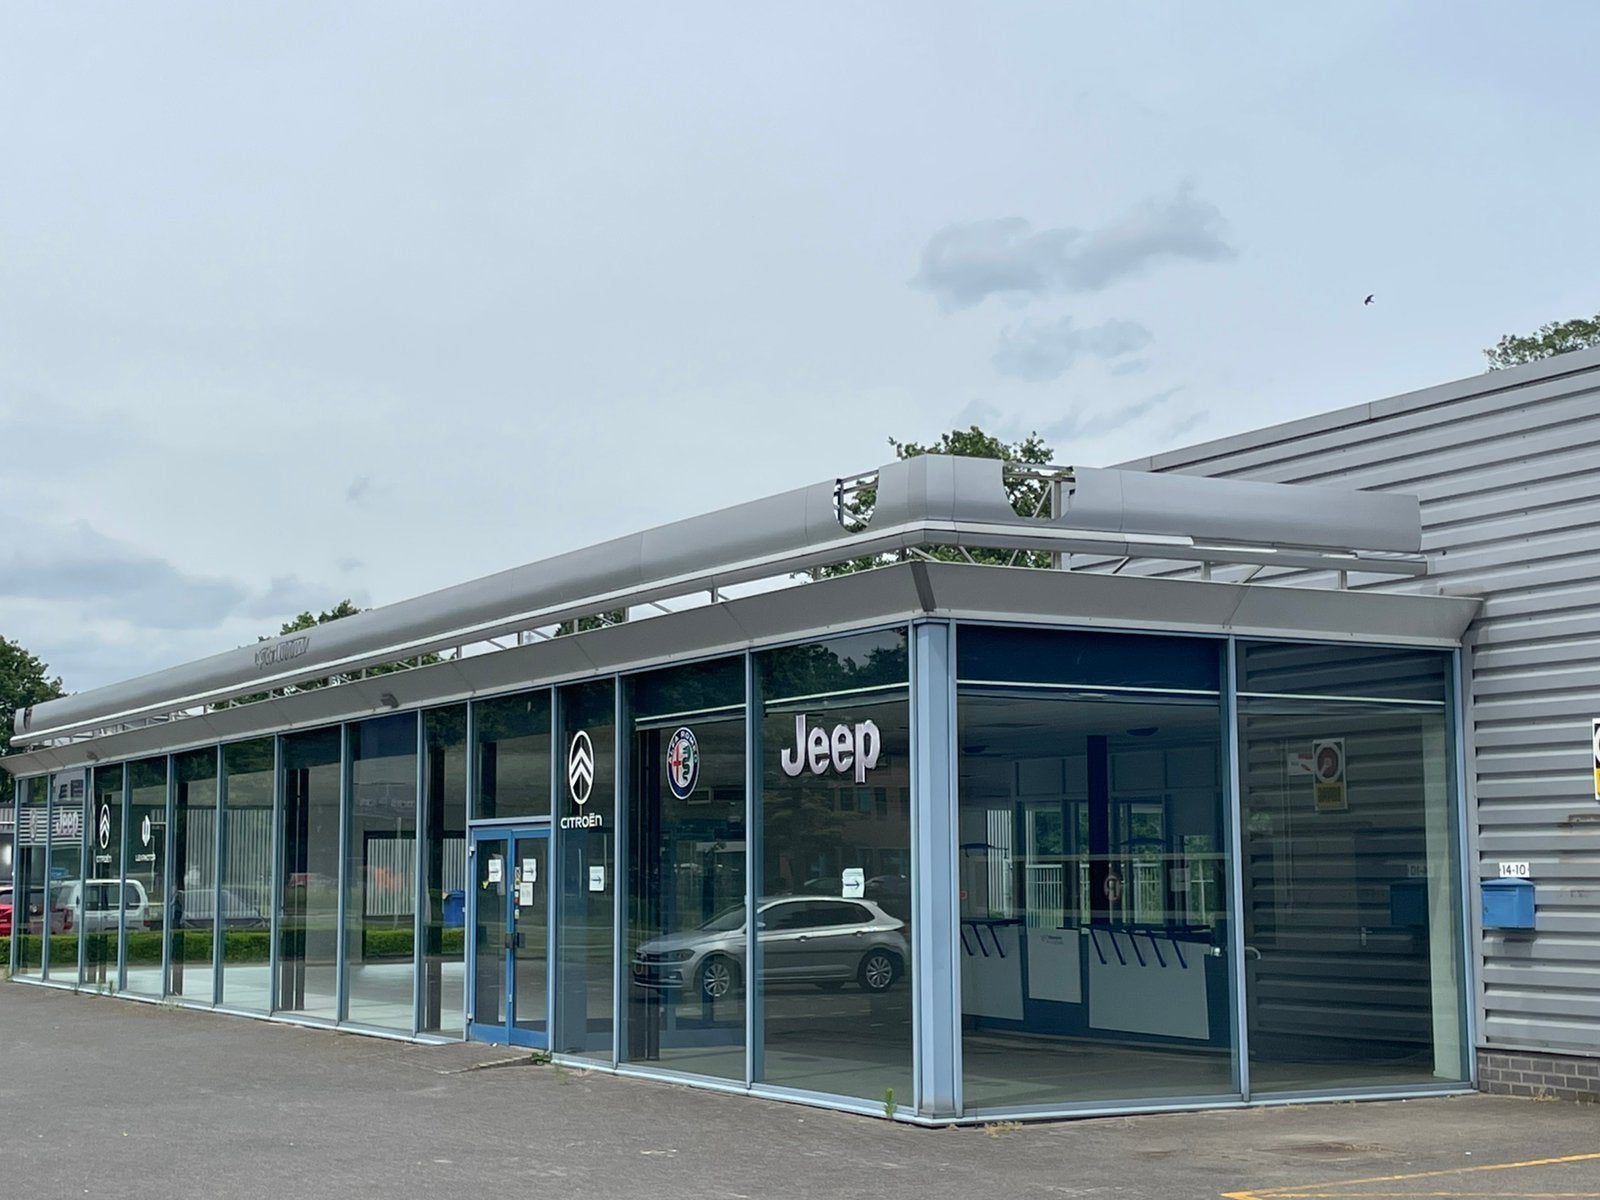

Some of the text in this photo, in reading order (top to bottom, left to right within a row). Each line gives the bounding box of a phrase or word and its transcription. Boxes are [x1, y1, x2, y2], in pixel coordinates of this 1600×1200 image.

[781, 714, 880, 783] Jeep
[56, 806, 79, 838] Jeep
[1501, 864, 1526, 876] 14-10
